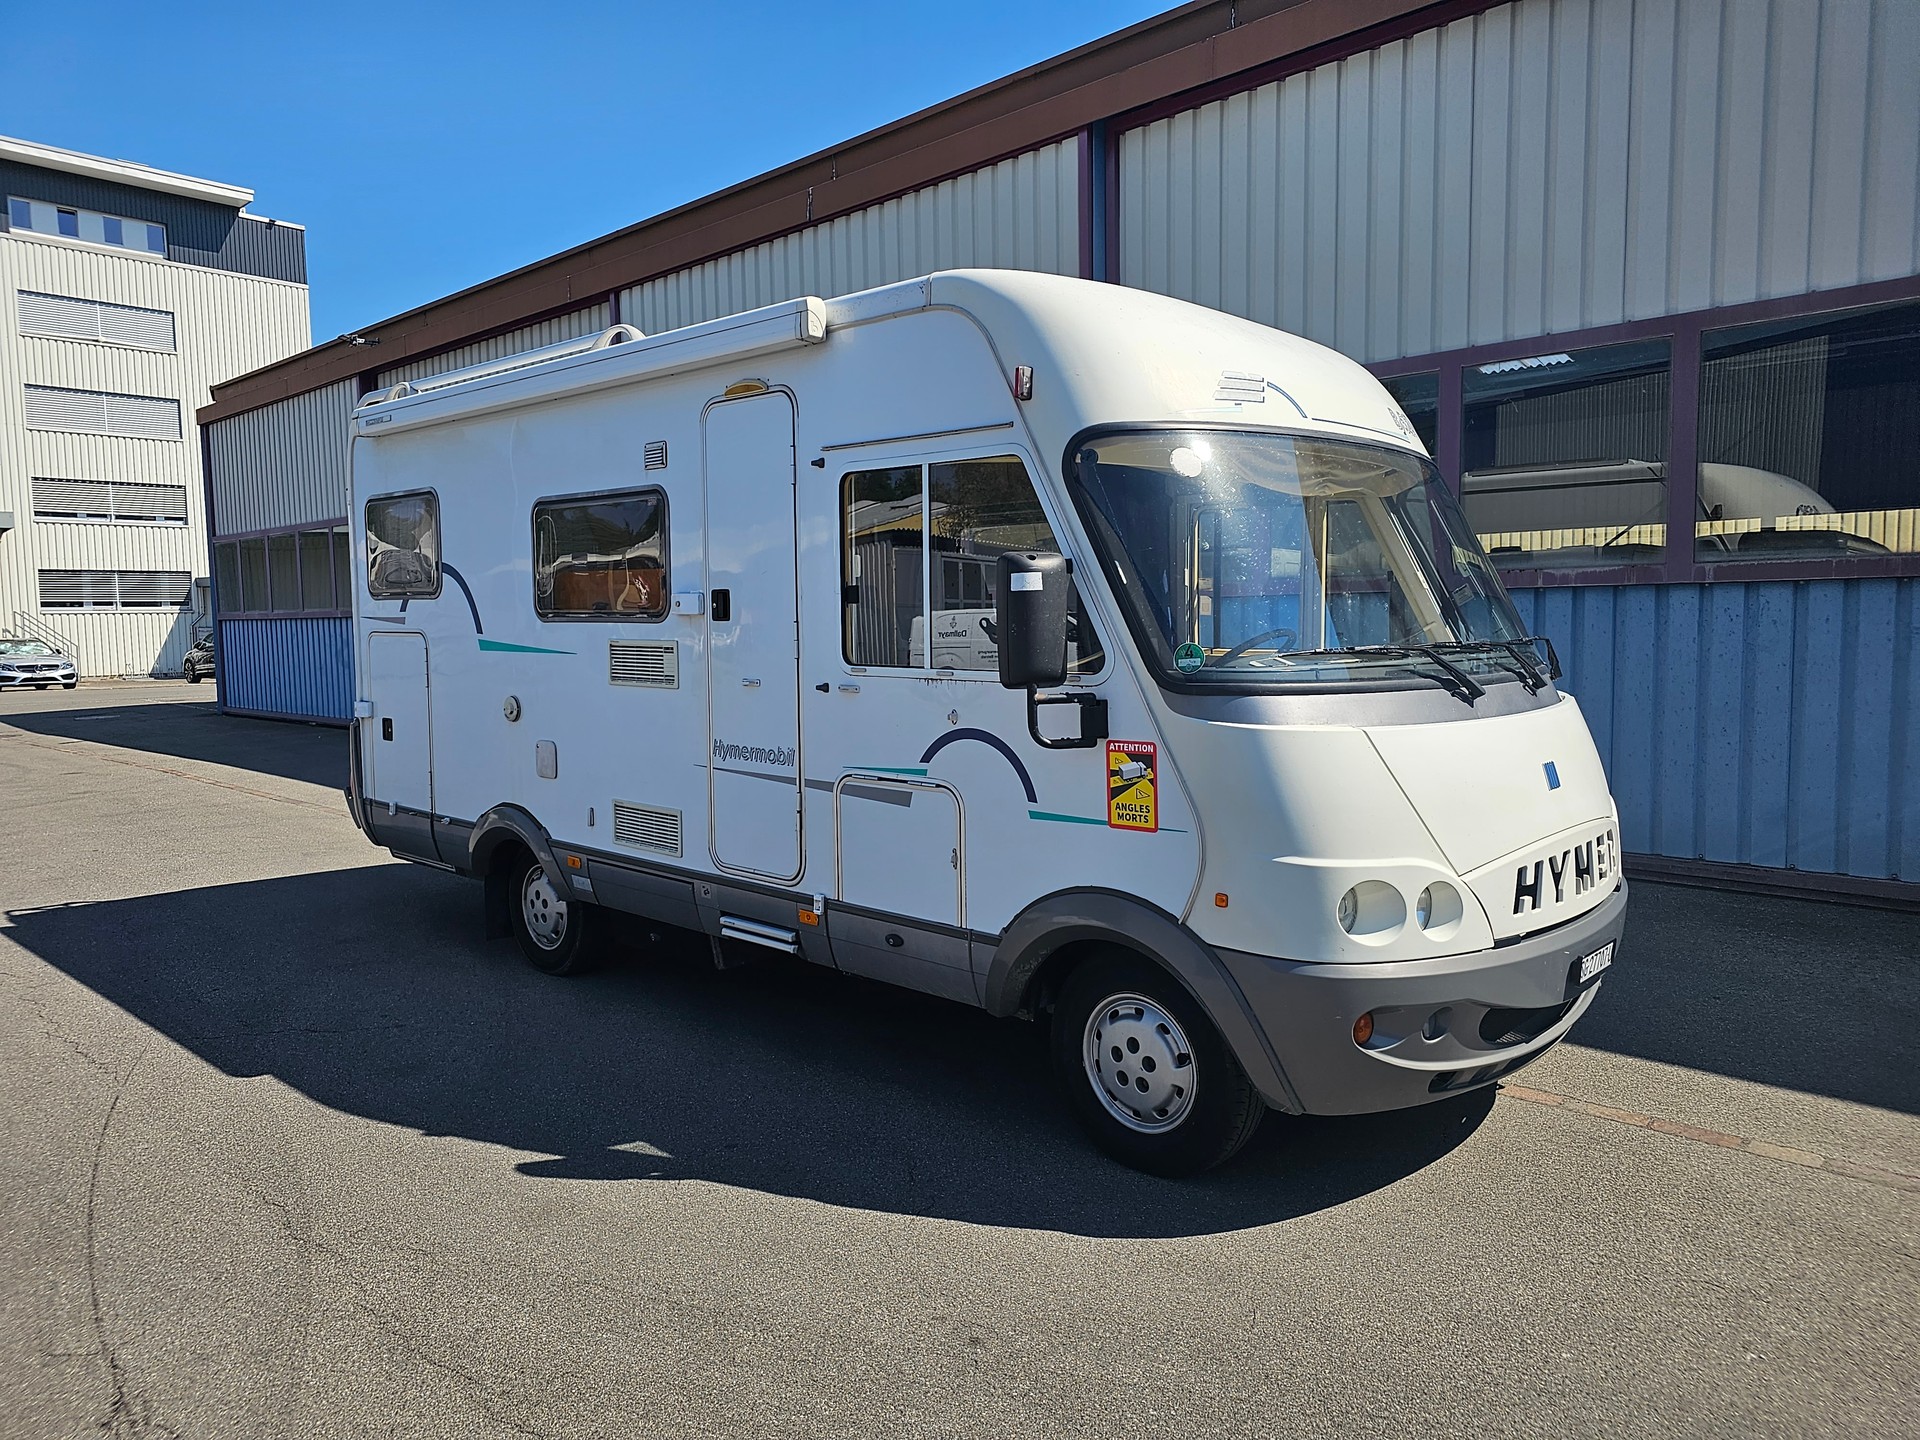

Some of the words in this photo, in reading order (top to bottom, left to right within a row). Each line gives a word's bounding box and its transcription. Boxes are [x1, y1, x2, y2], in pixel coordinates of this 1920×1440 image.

[713, 738, 797, 767] Hymermobil
[1109, 743, 1153, 752] ATTENTION
[1115, 802, 1150, 813] ANGLES
[1117, 813, 1149, 823] MORTS
[1513, 829, 1616, 916] HYMER
